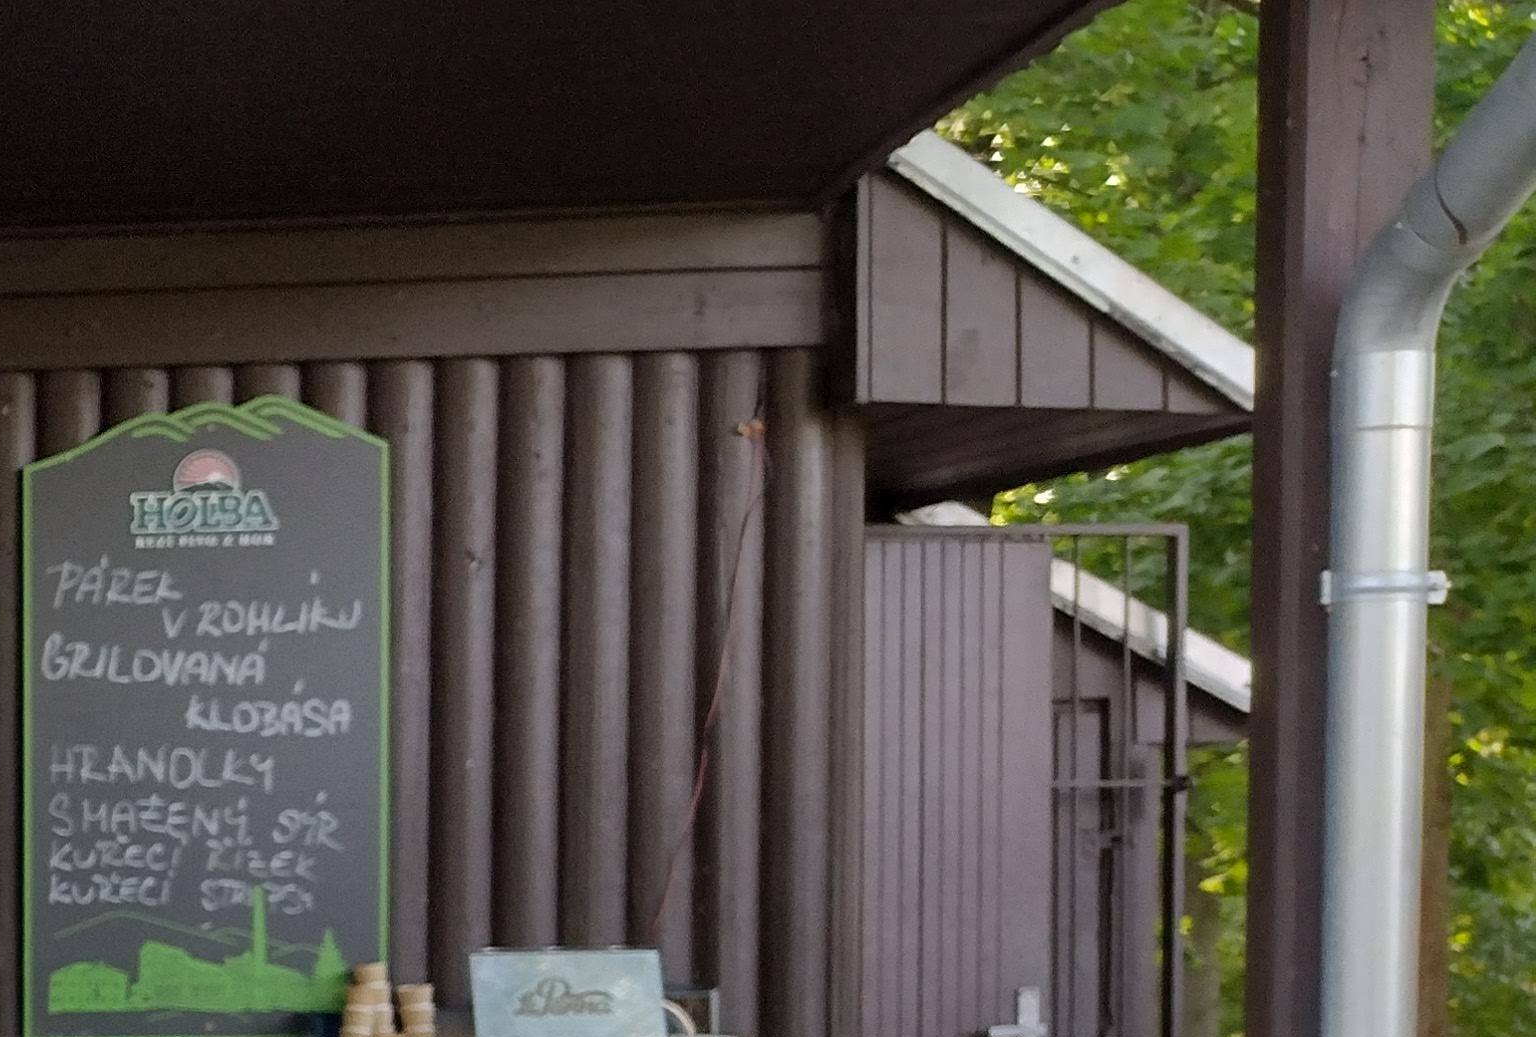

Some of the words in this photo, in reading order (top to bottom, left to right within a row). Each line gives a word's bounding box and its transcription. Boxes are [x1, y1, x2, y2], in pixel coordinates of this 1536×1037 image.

[130, 489, 279, 535] HOLBA
[46, 554, 183, 610] PÁREK
[162, 608, 188, 639] V
[40, 630, 270, 686] GRILOVANÁ
[185, 678, 354, 737] KLOBÁSA
[535, 977, 615, 1016] Panna
